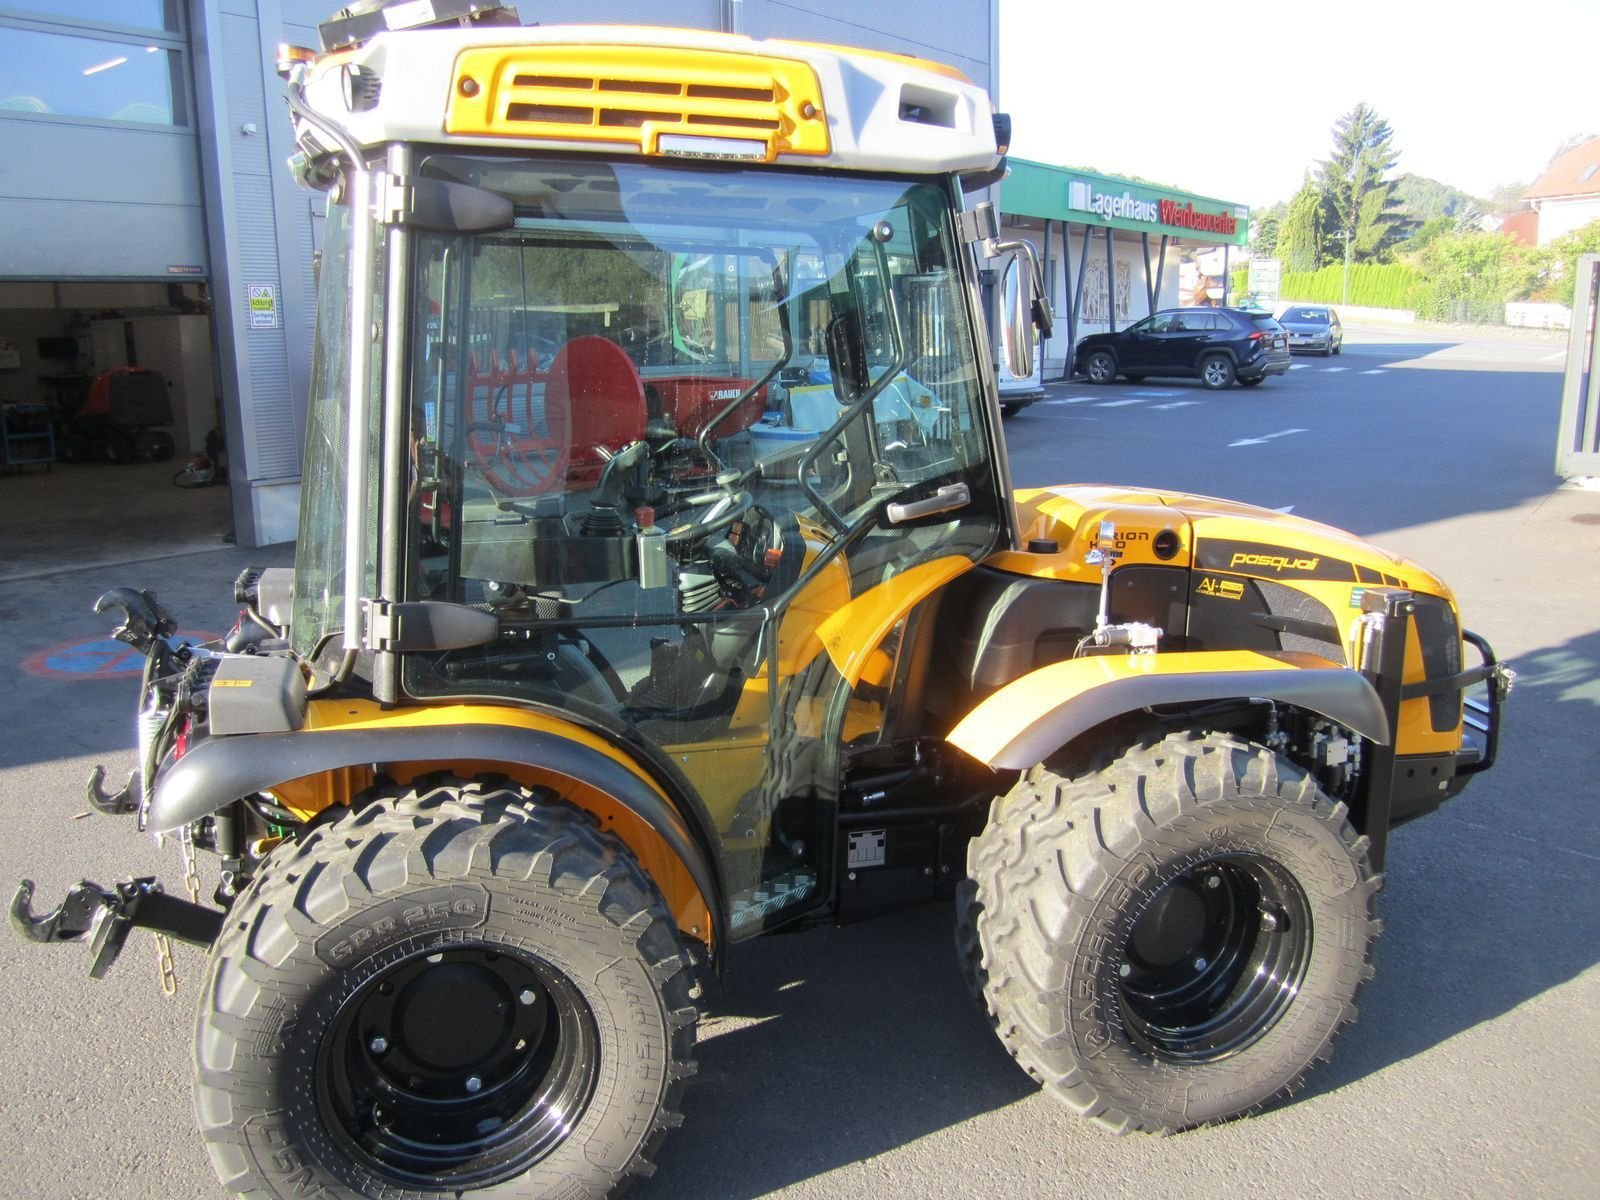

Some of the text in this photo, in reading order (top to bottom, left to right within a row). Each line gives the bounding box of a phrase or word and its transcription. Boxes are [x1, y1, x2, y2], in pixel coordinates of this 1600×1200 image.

[1087, 183, 1237, 235] Lagerhaus Weinbaucenter
[1230, 553, 1319, 571] pasquali
